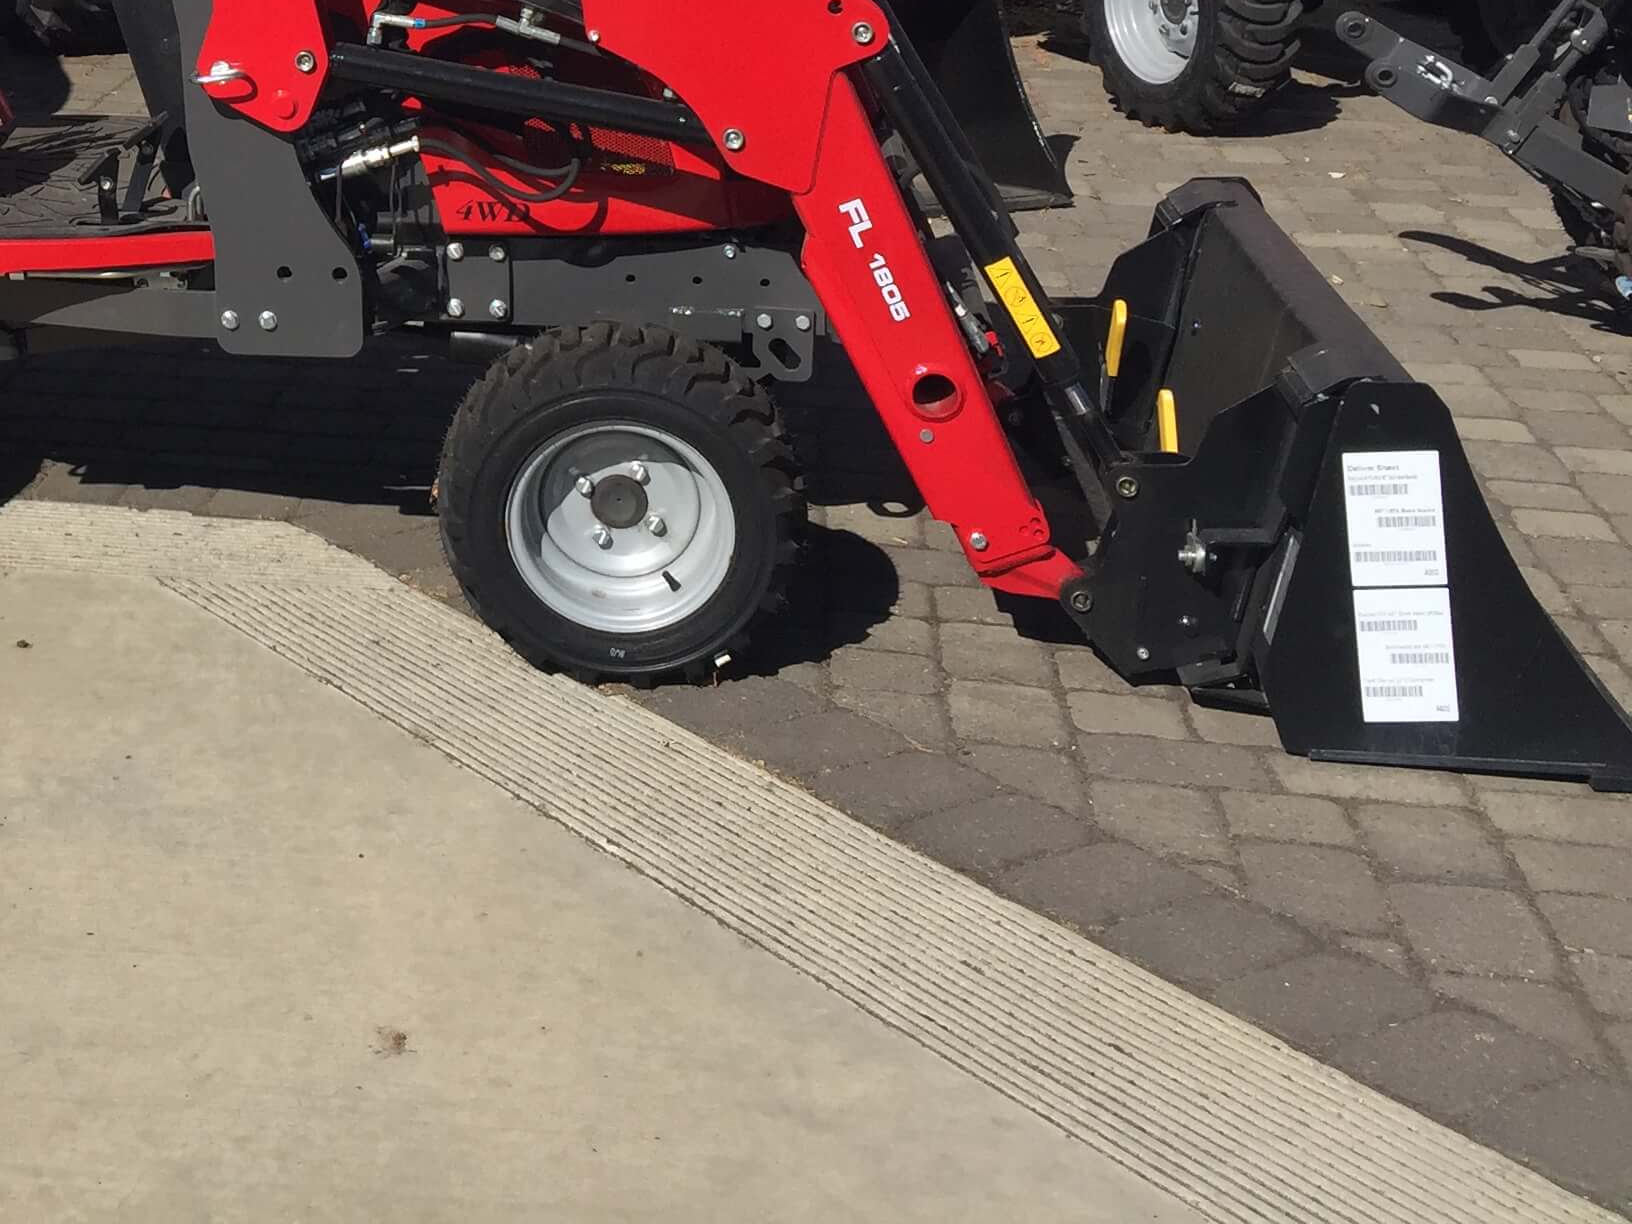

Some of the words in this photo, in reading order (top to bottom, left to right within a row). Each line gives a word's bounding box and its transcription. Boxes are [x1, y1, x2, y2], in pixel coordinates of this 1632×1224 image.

[455, 199, 531, 223] 4WD
[838, 198, 873, 249] FL
[868, 252, 911, 322] 1805
